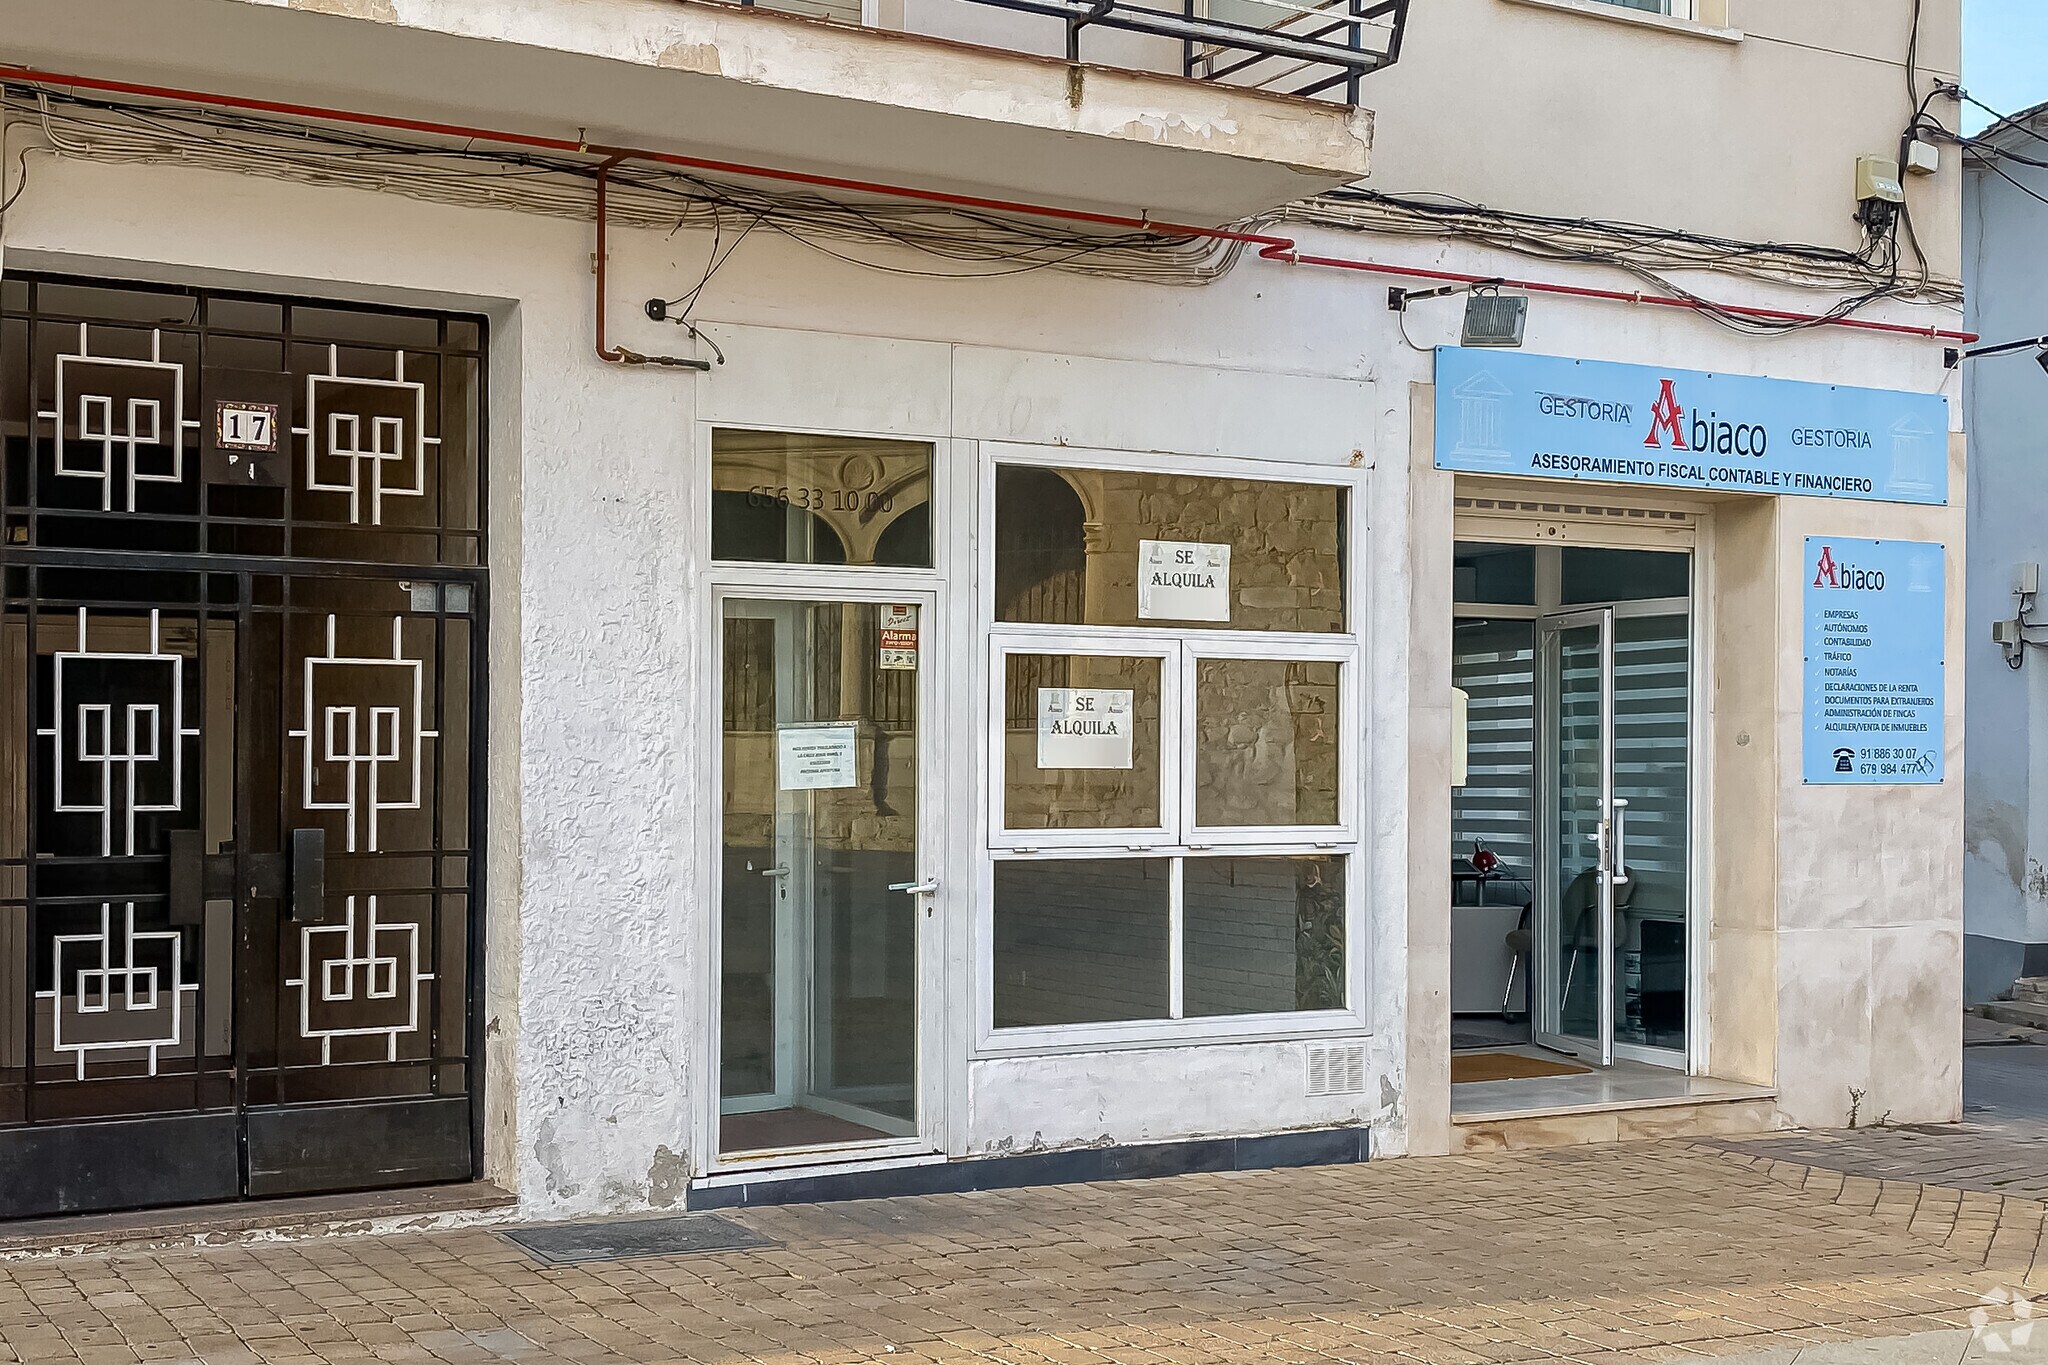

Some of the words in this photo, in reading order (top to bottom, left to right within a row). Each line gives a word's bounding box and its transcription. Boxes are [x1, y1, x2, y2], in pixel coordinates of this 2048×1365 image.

[1643, 379, 1767, 457] Abiaco
[229, 414, 266, 441] 17
[1531, 453, 1654, 476] ASESORAMIENTO
[1658, 463, 1705, 480] FISCAL
[1709, 467, 1779, 486] CONTABLE
[1783, 472, 1792, 486] Y
[1795, 473, 1872, 492] FINANCIERO
[746, 485, 789, 508] 656
[798, 488, 824, 510] 33
[831, 490, 859, 512] 10
[865, 491, 893, 513] 00
[1175, 549, 1194, 565] SE
[1813, 546, 1885, 590] Abiaco
[1151, 572, 1216, 589] ALQUILA
[1824, 609, 1859, 620] EMPRESAS
[1823, 622, 1868, 633] AUTÓNOMOS
[882, 630, 917, 641] Alarma
[1823, 637, 1872, 647] CONTABILIDAD
[1824, 651, 1852, 661] TRÁFICO
[1824, 666, 1857, 677] NOTARÍAS
[1824, 682, 1878, 692] DECLARACIONES
[1879, 684, 1888, 692] DE
[1889, 684, 1897, 692] LA
[1898, 684, 1919, 693] RENTA
[1076, 697, 1095, 711] SE
[1824, 696, 1872, 705] DOCUMENTOS
[1873, 697, 1890, 705] PARA
[1891, 697, 1934, 706] EXTRANJEROS
[1824, 707, 1882, 717] ADMINISTRACIÓN
[1883, 709, 1892, 717] DE
[1893, 709, 1916, 718] FINCAS
[1051, 720, 1119, 736] ALQUILA
[1825, 723, 1880, 732] ALQUILER/VENTA
[1881, 723, 1890, 732] DE
[1891, 723, 1928, 732] INMUEBLES
[1860, 748, 1871, 759] 91
[1874, 748, 1890, 759] 886
[1893, 748, 1904, 759] 30
[1906, 748, 1917, 759] 07
[1860, 763, 1877, 775] 679
[1880, 763, 1897, 775] 984
